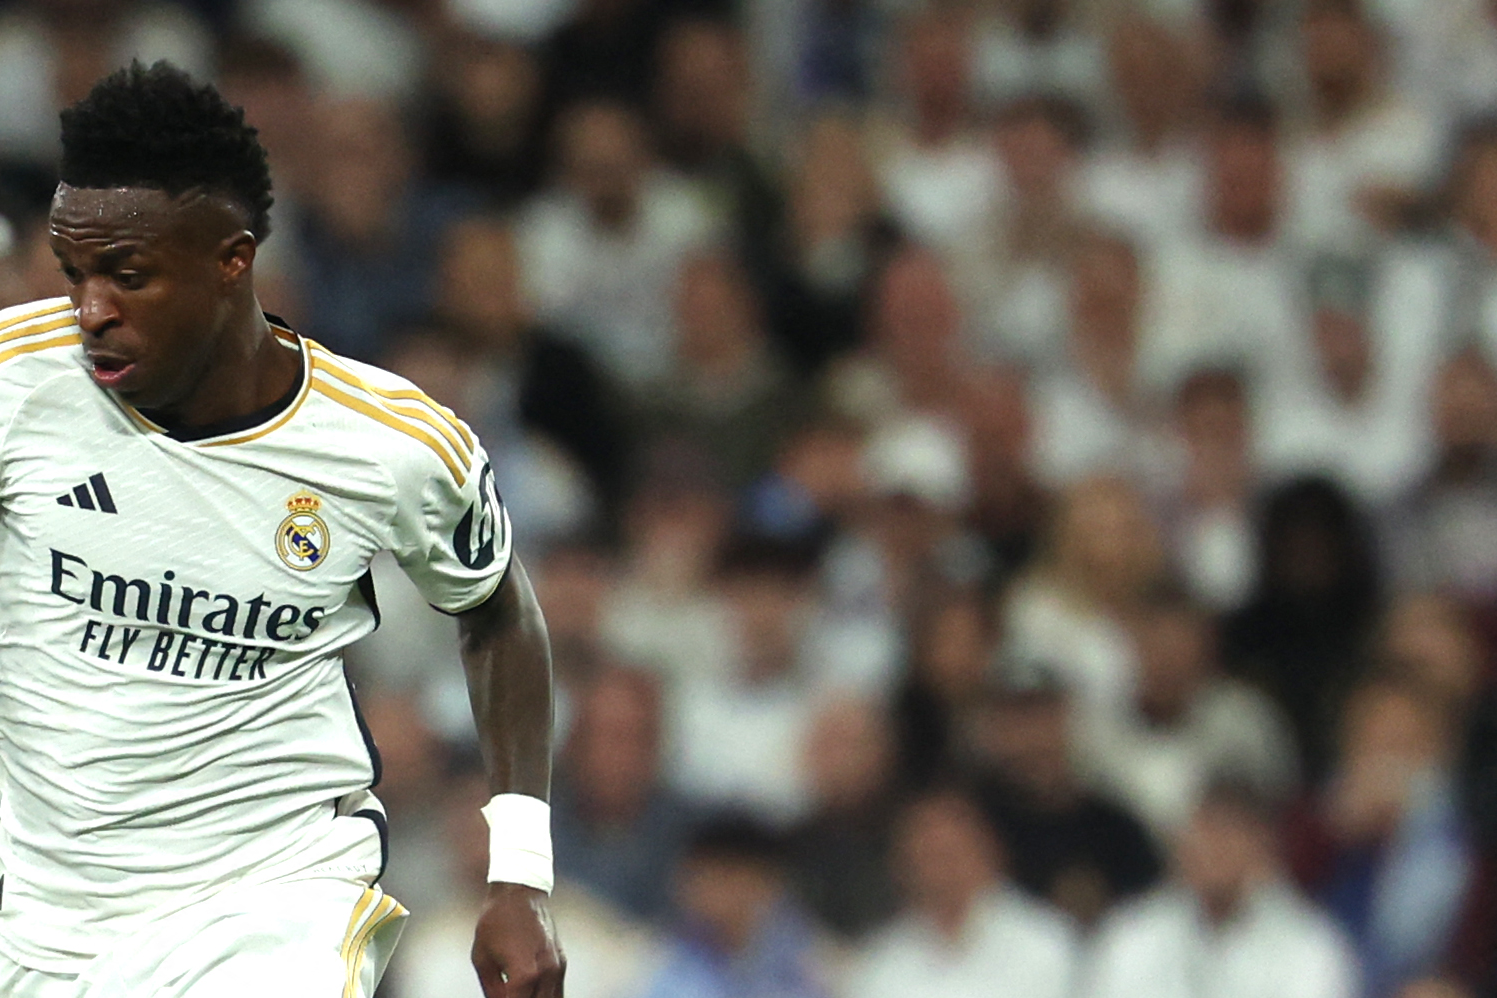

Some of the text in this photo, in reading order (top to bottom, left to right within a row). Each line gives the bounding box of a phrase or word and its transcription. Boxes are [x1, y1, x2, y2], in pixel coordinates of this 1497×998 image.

[49, 548, 325, 643] Emirates
[79, 619, 277, 682] FLY BETTER
